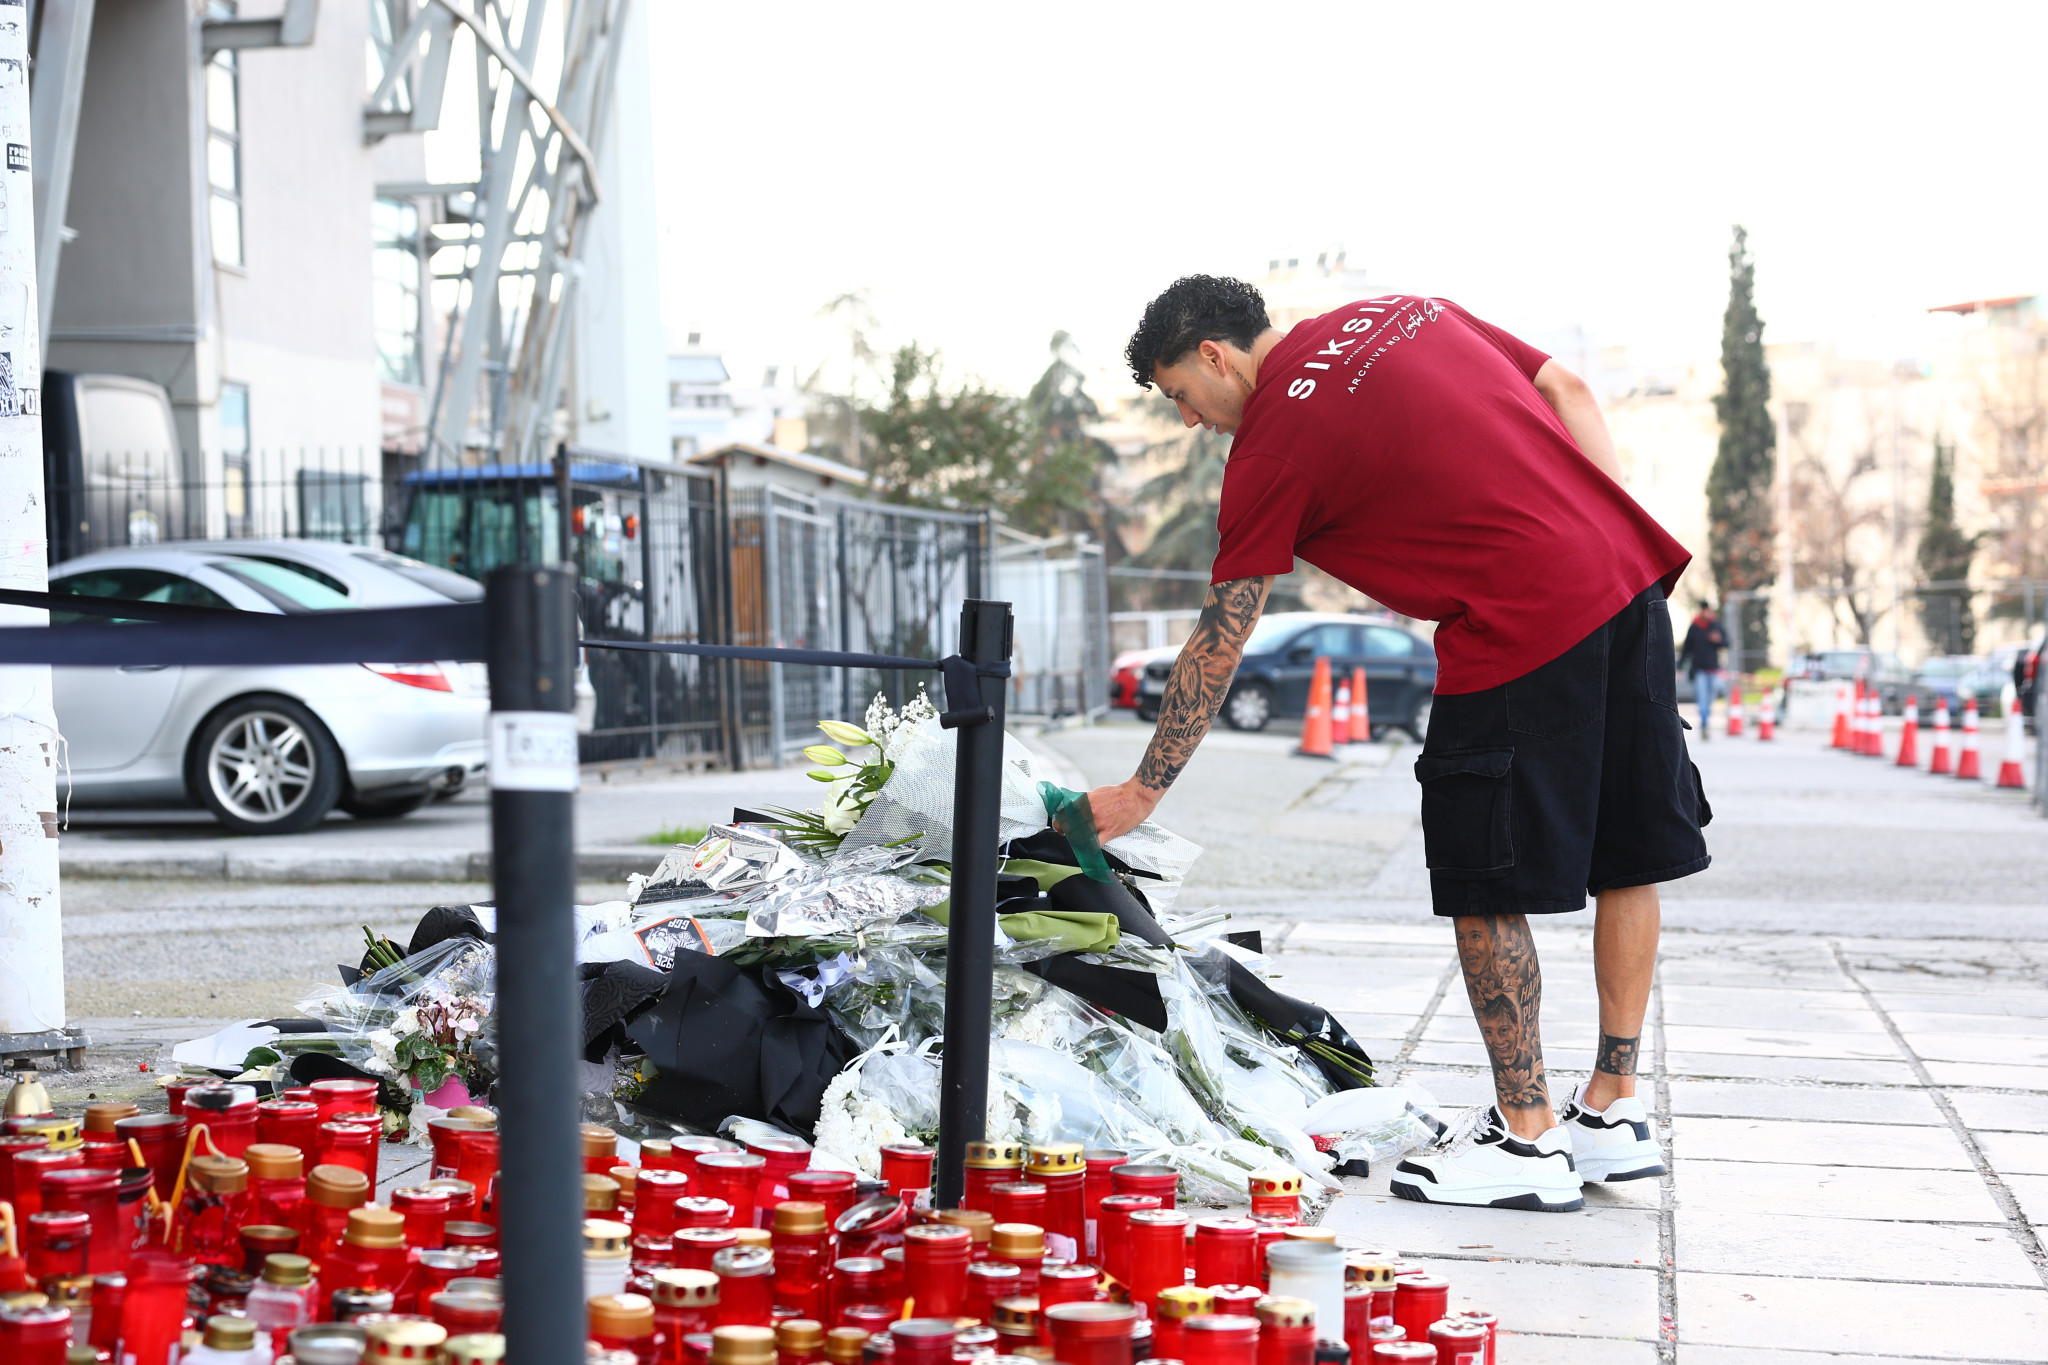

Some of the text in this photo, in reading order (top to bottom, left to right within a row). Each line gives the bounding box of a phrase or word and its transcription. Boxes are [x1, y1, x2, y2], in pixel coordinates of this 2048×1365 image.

[1287, 296, 1403, 400] SIKSIL
[1347, 347, 1388, 394] ARCHIVE
[1521, 971, 1541, 1004] HAPP
[1523, 992, 1541, 1025] PLAC
